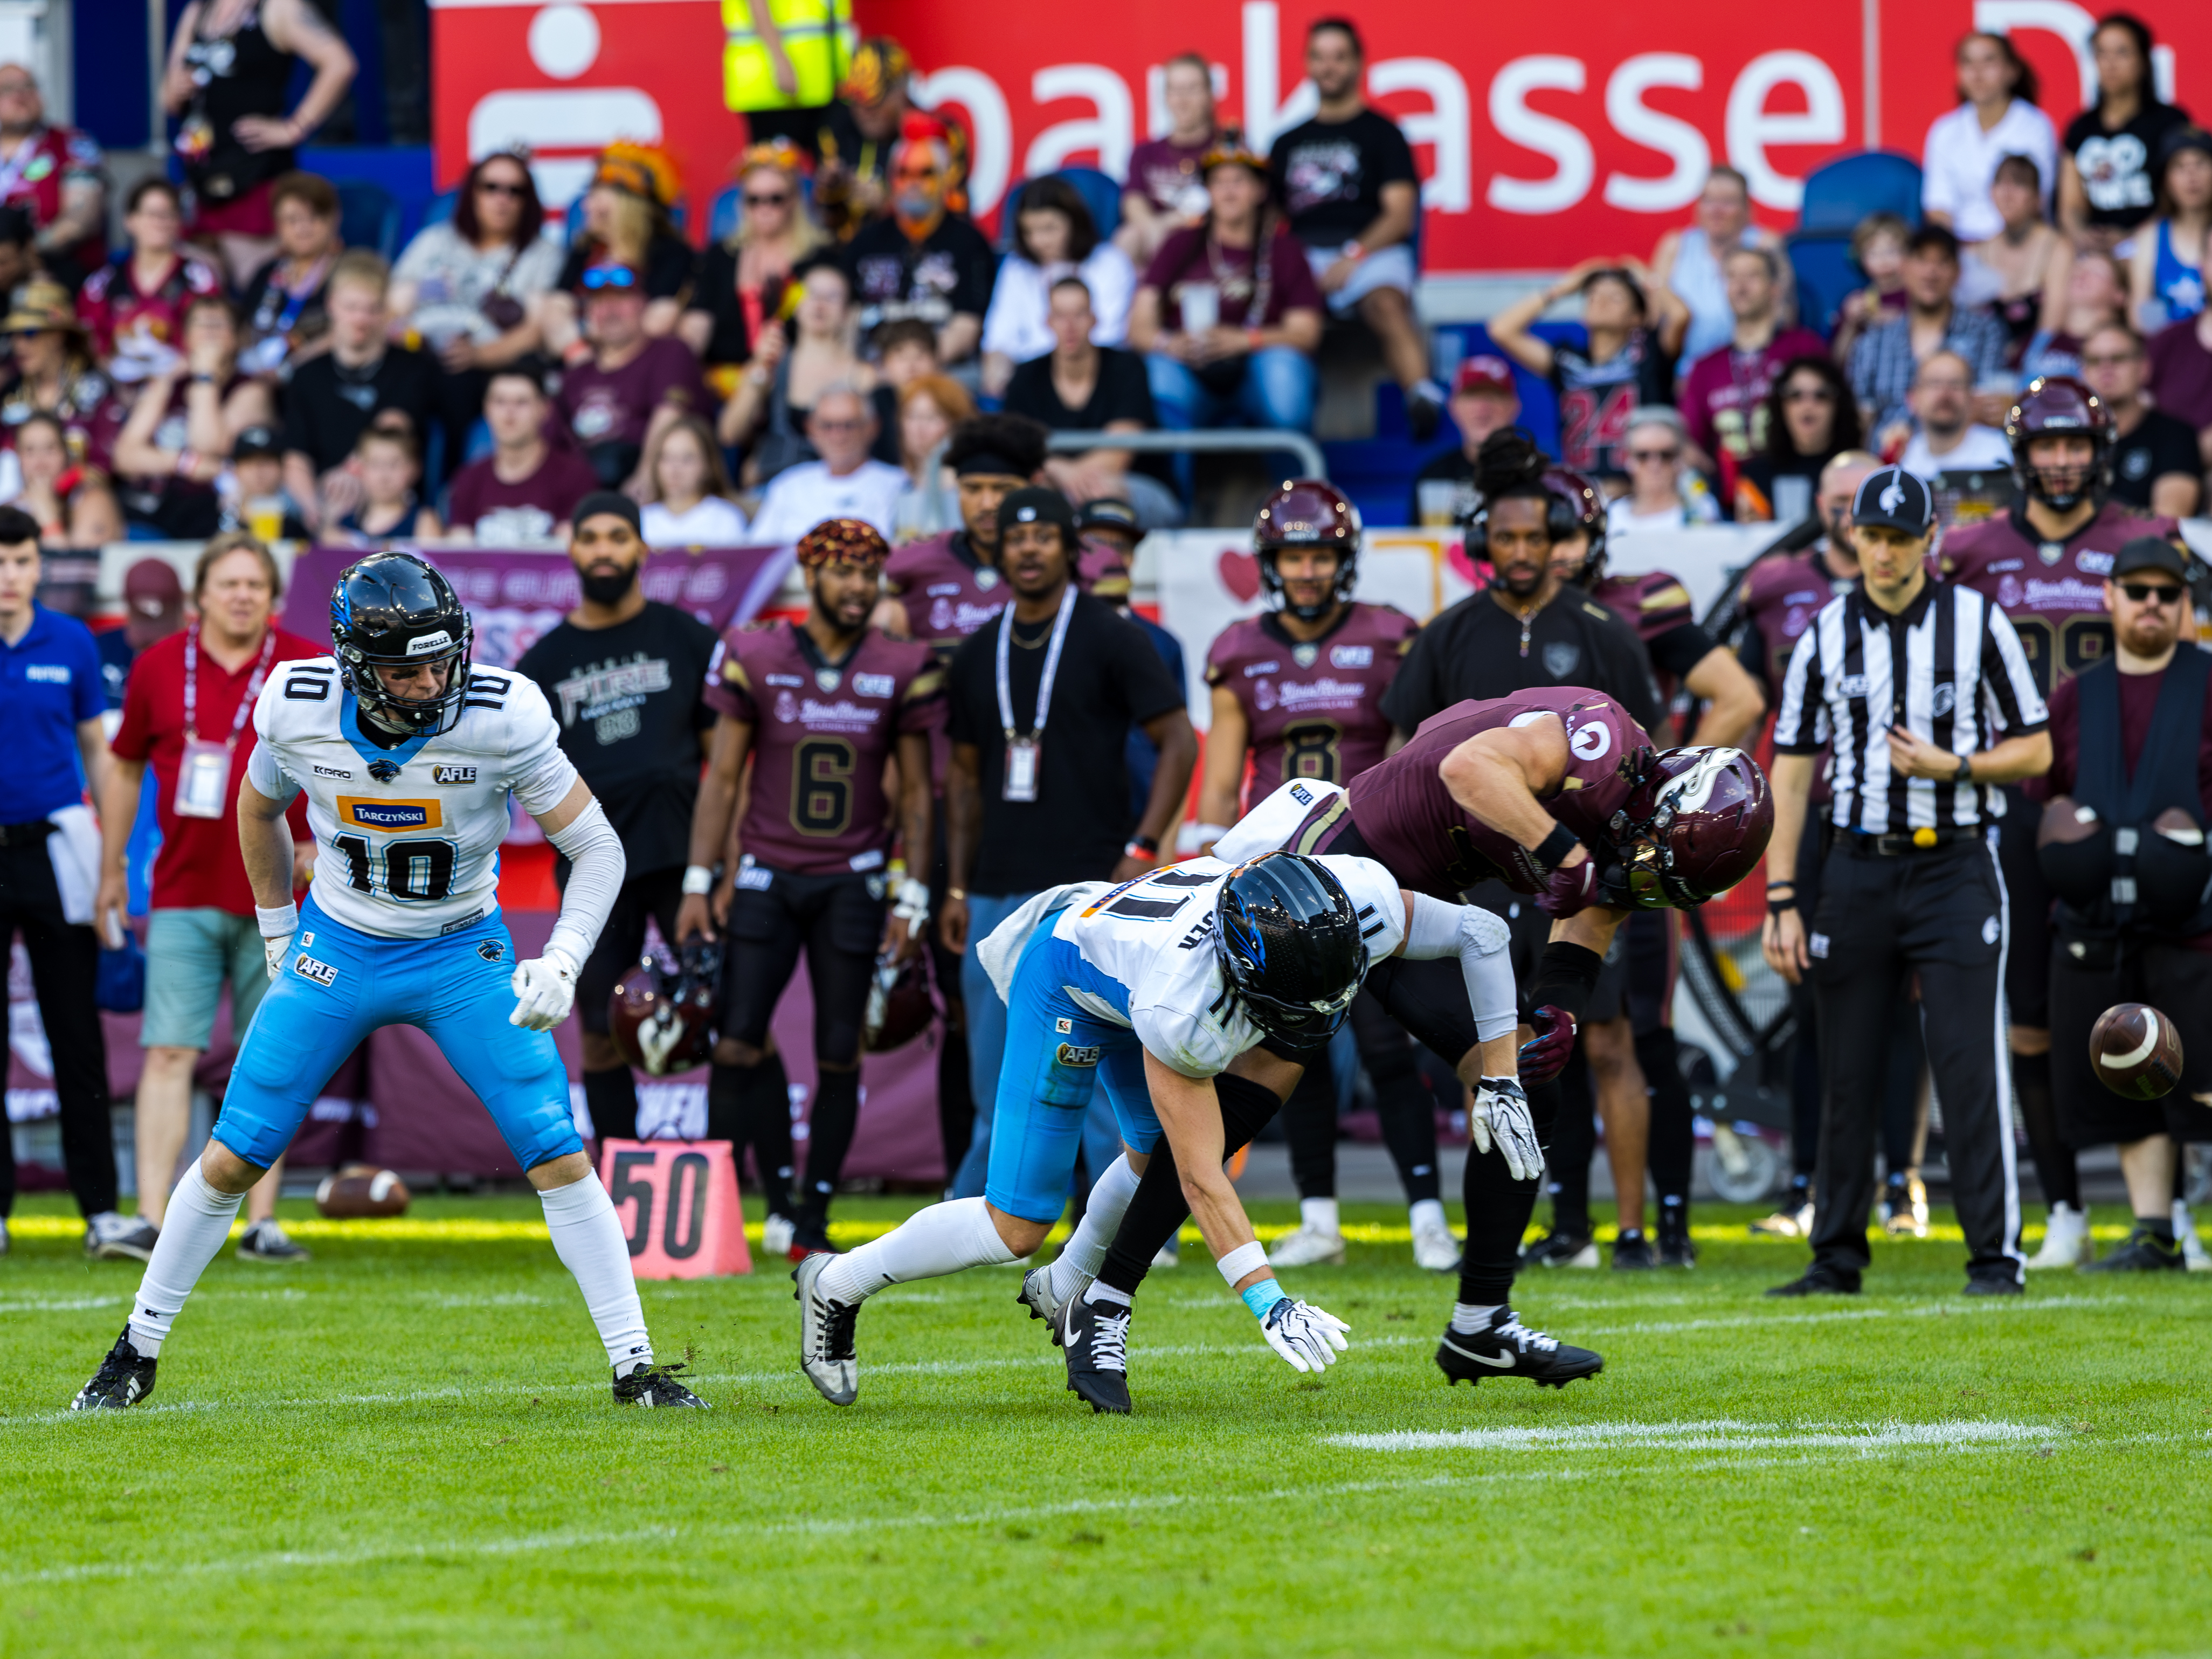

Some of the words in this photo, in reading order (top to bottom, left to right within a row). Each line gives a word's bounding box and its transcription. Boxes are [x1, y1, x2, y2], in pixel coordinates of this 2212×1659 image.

[908, 1, 1847, 218] parkasse
[411, 636, 449, 651] FORELLE
[284, 665, 337, 702] 10
[465, 672, 511, 712] 10
[438, 768, 475, 781] AFLE
[790, 735, 858, 837] 6
[356, 808, 424, 821] TARCZYŃSKI
[331, 831, 459, 901] 10
[298, 958, 336, 982] AFLE
[1063, 1048, 1098, 1062] AFLE
[611, 1151, 710, 1260] 50
